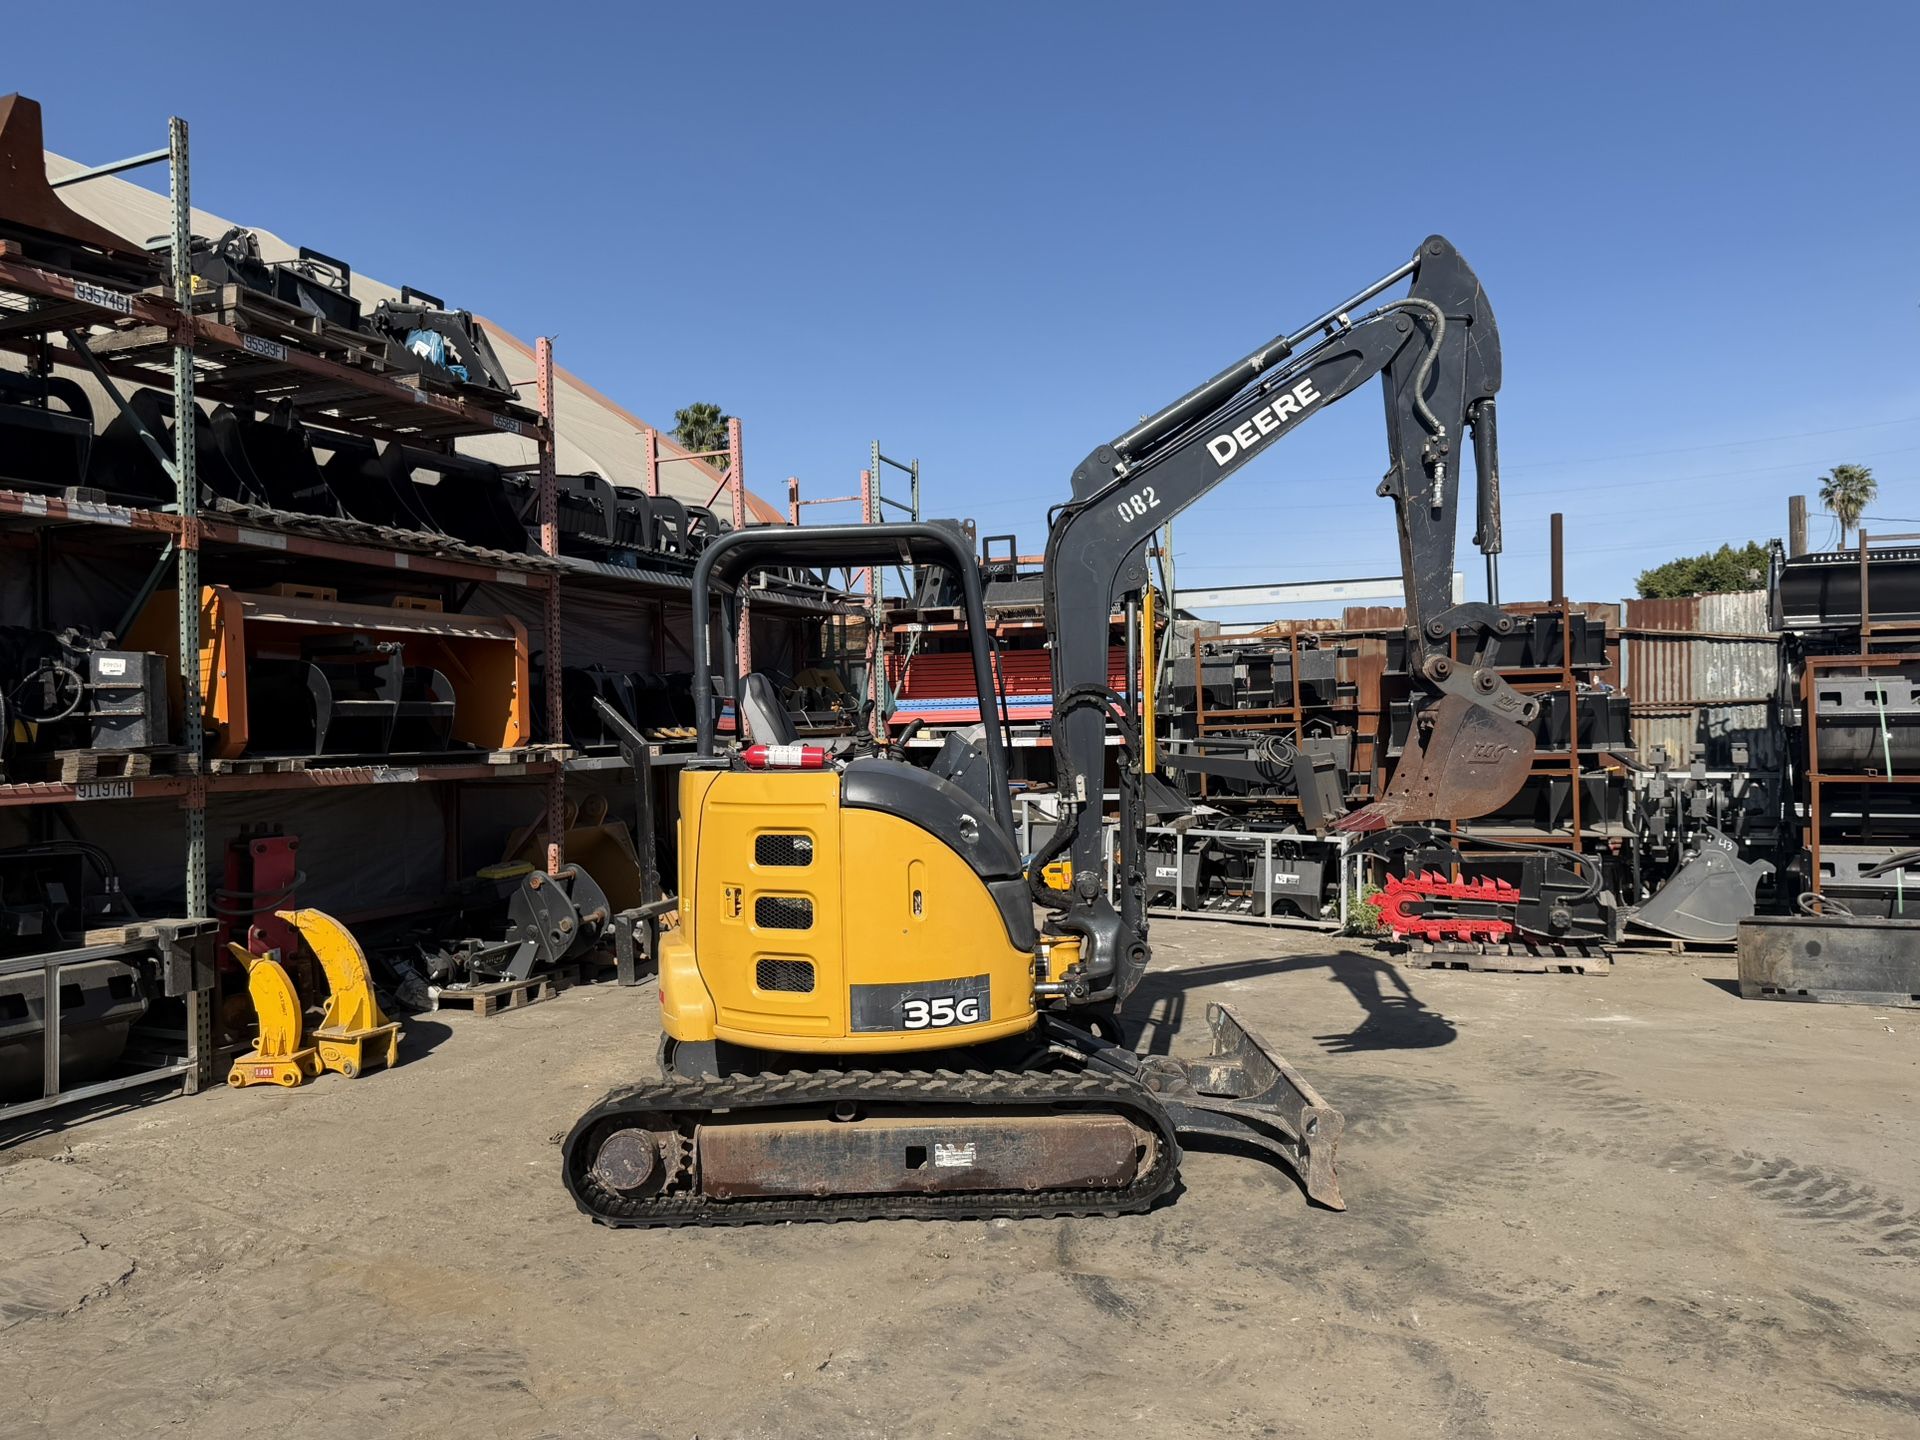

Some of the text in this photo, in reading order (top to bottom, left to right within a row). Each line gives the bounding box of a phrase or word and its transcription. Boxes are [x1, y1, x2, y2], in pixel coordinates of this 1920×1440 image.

[77, 284, 125, 311] 93574G
[246, 335, 280, 358] 95589F
[1206, 378, 1321, 466] DEERE
[1117, 486, 1160, 522] 082
[78, 782, 126, 798] 91197A
[1718, 838, 1733, 851] 43
[904, 997, 979, 1029] 35G
